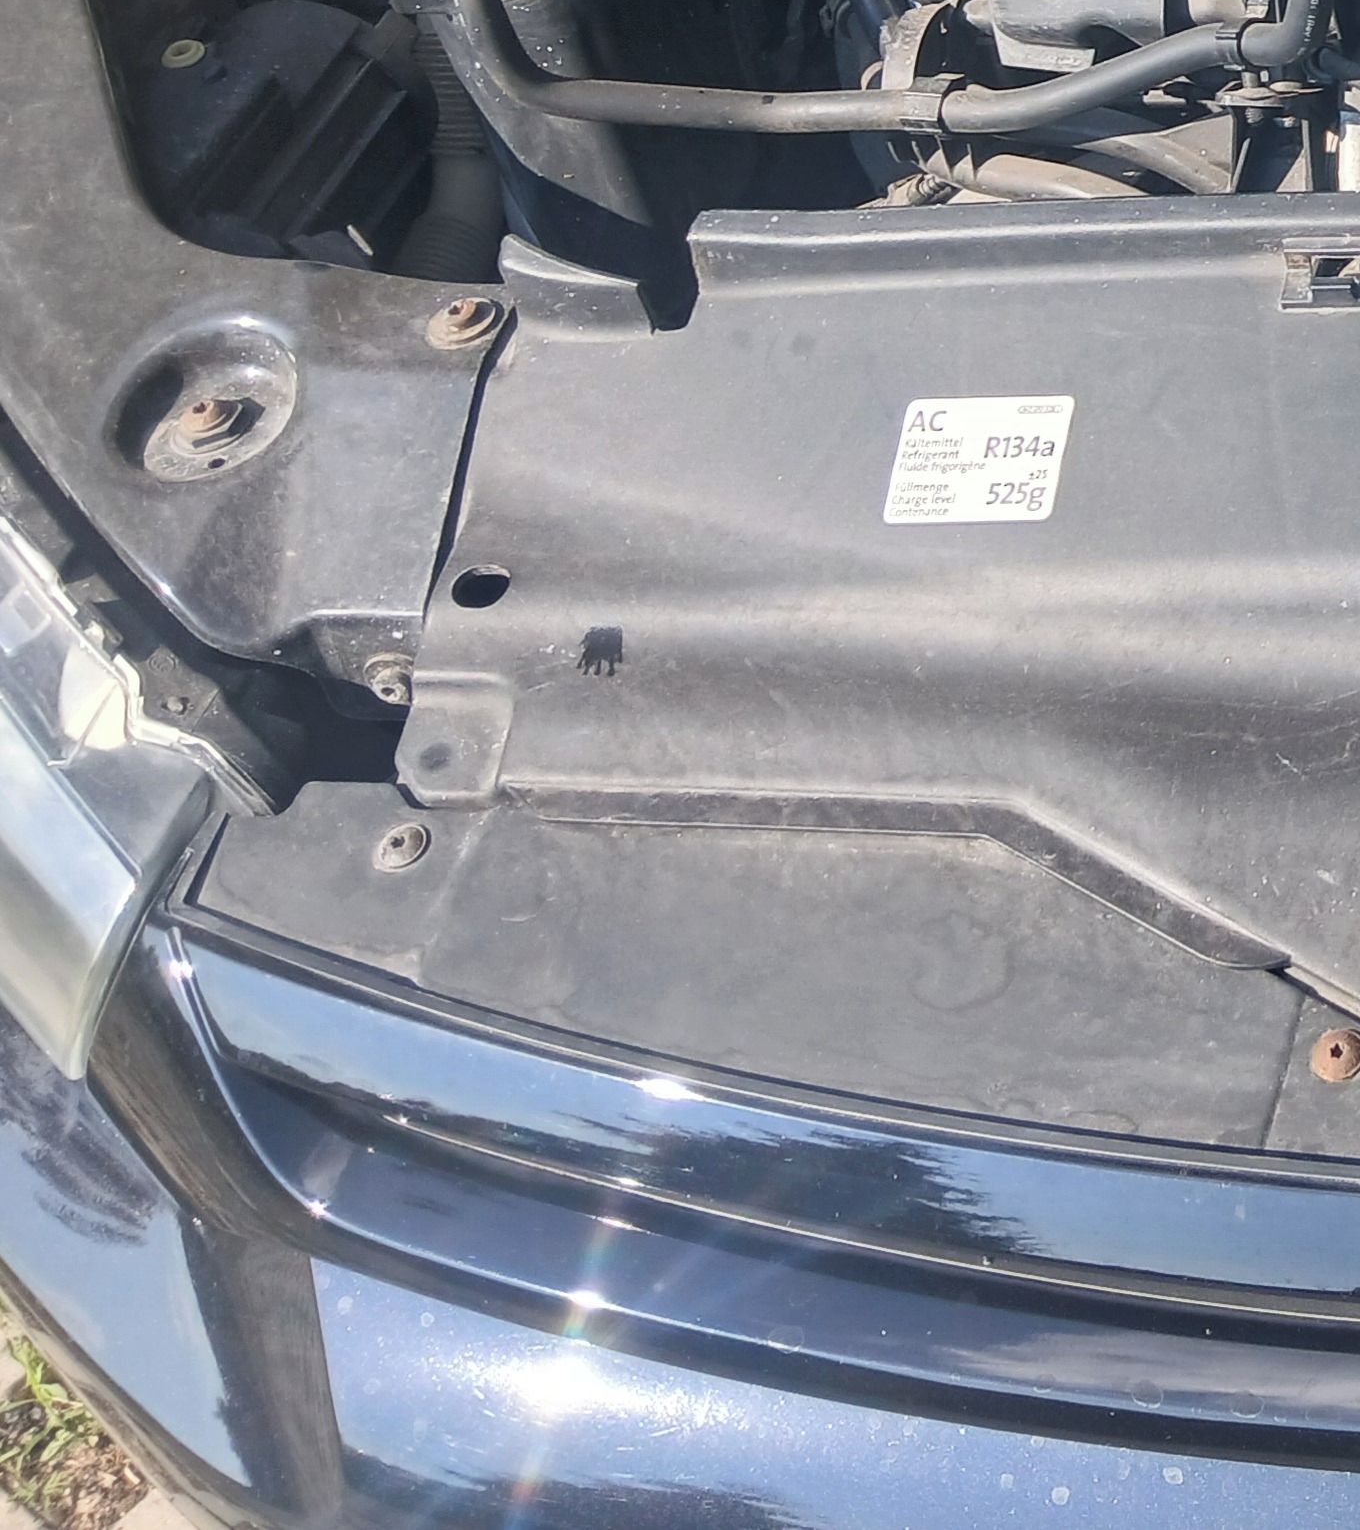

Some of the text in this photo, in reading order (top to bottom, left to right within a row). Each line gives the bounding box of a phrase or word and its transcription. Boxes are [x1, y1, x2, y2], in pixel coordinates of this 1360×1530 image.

[907, 410, 948, 432] AC
[901, 450, 960, 461] Refrigerant
[983, 435, 1056, 458] R134a
[931, 494, 956, 504] level
[985, 482, 1047, 511] 525g
